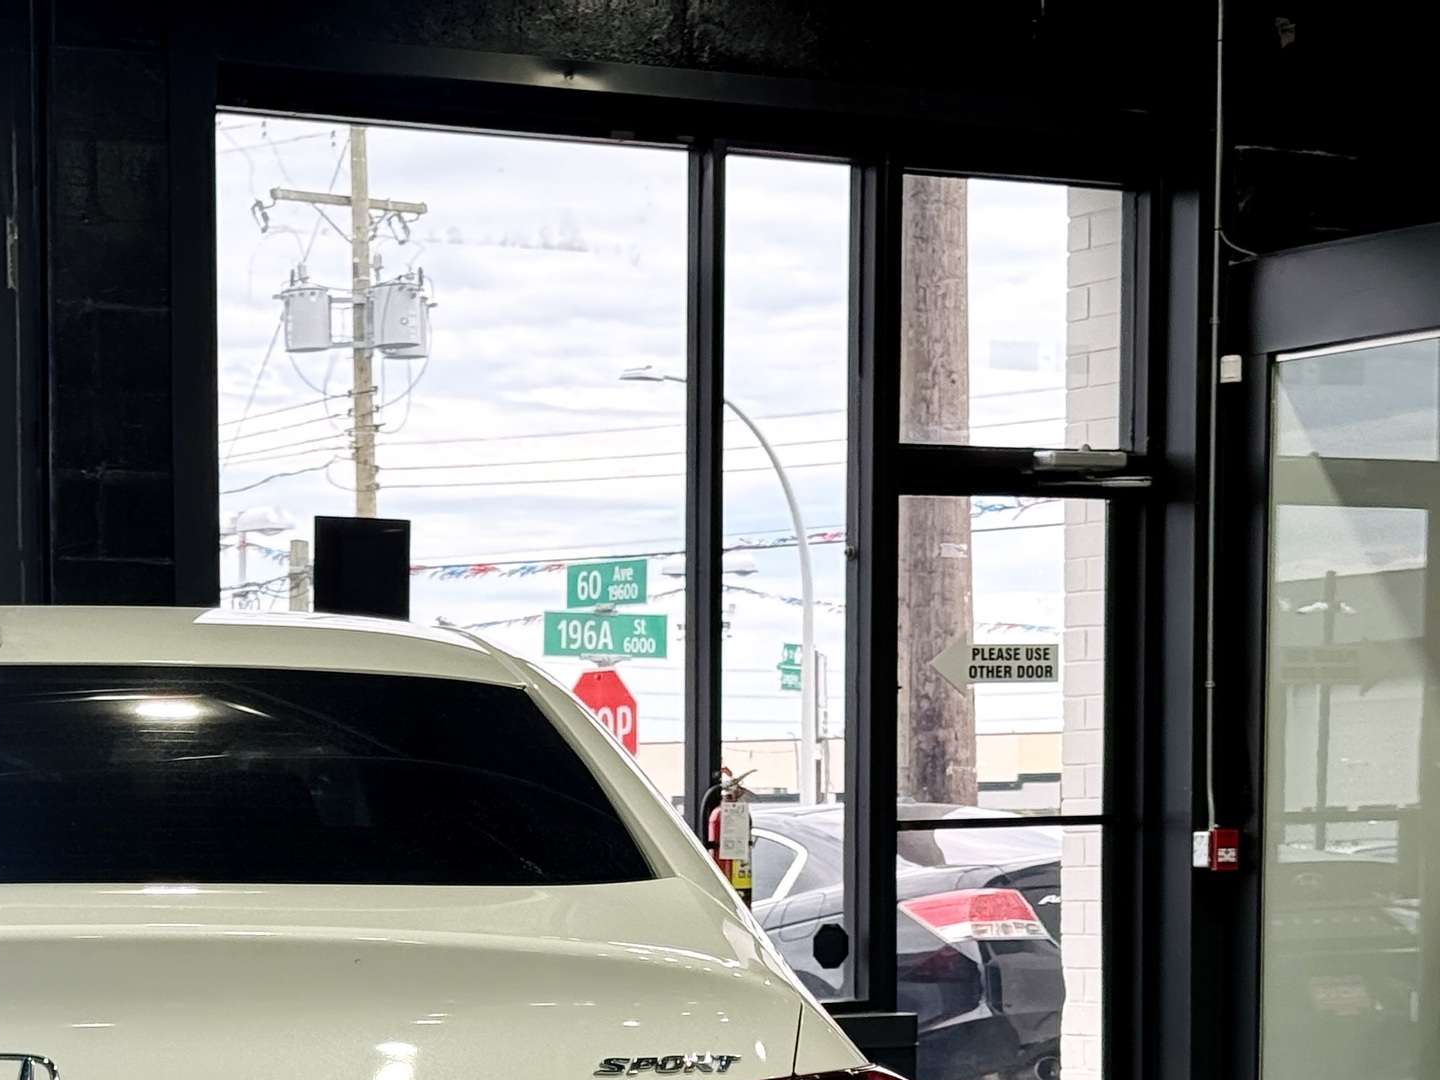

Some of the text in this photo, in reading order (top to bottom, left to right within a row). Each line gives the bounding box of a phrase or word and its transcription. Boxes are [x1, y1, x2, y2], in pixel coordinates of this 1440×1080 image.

[577, 566, 634, 601] 60 Ave
[608, 583, 639, 601] 19600
[557, 619, 648, 650] 196A St
[623, 637, 656, 653] 6000
[971, 647, 1050, 661] PLEASE USE
[968, 665, 1053, 679] OTHER DOOR
[593, 1055, 742, 1076] SPORT
